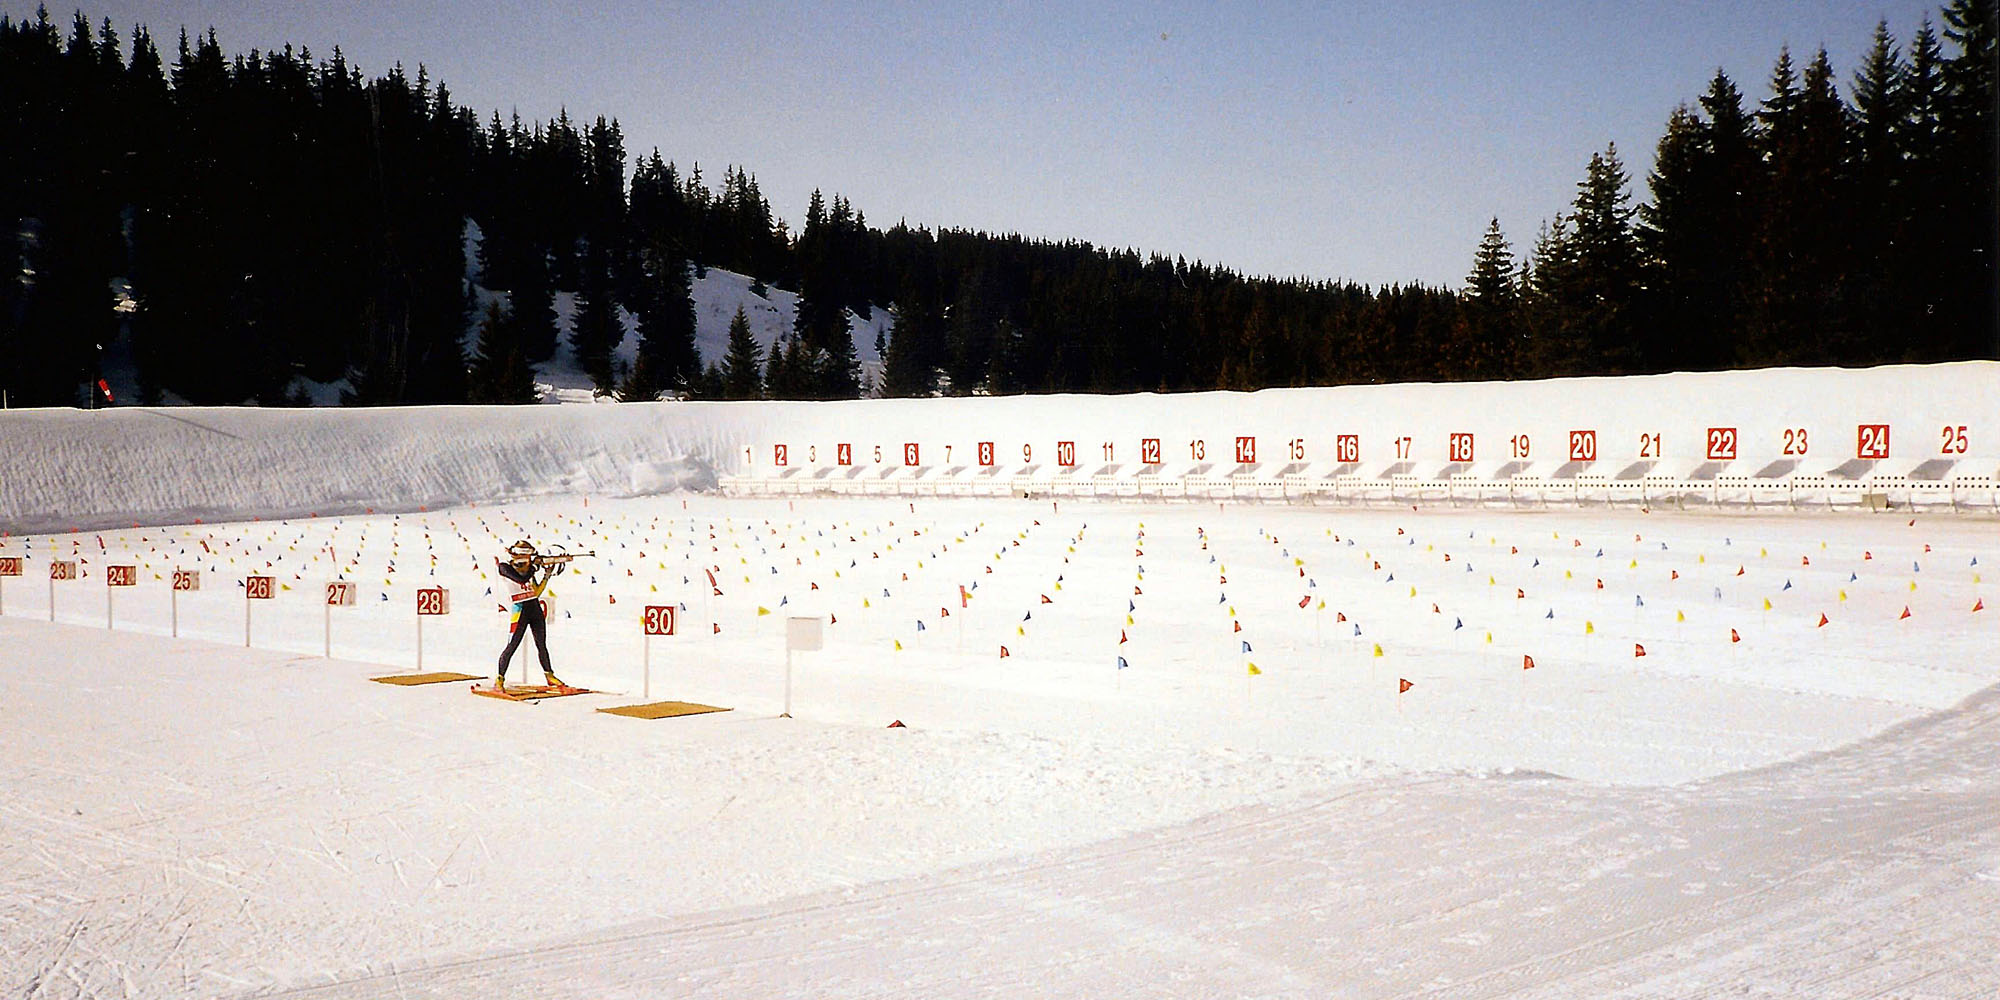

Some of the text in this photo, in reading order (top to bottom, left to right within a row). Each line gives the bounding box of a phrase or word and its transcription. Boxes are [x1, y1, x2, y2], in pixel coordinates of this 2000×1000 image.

[1190, 440, 1205, 460] 13
[1237, 438, 1254, 461] 14
[1289, 438, 1304, 460] 15
[1338, 437, 1356, 461] 16
[1395, 437, 1411, 459] 17
[1451, 435, 1472, 460] 18
[1510, 434, 1530, 457] 19
[1571, 433, 1594, 459] 20
[1640, 433, 1660, 457] 21
[1710, 430, 1734, 457] 22
[1783, 428, 1808, 455] 23
[1861, 427, 1887, 456] 24
[1942, 426, 1968, 454] 25
[746, 447, 751, 464] 1
[777, 446, 785, 464] 2
[809, 445, 815, 462] 3
[840, 445, 848, 464] 4
[875, 445, 881, 463] 5
[907, 445, 916, 464] 6
[945, 445, 952, 463] 7
[981, 443, 991, 464] 8
[1024, 443, 1031, 463] 9
[1059, 443, 1073, 464] 10
[1102, 442, 1113, 461] 11
[1143, 440, 1159, 462] 12
[0, 559, 14, 575] 22
[51, 563, 66, 580] 23
[109, 568, 125, 585] 24
[173, 572, 191, 590] 25
[248, 578, 268, 598] 26
[327, 584, 347, 605] 27
[418, 591, 440, 614] 28
[647, 608, 672, 634] 30
